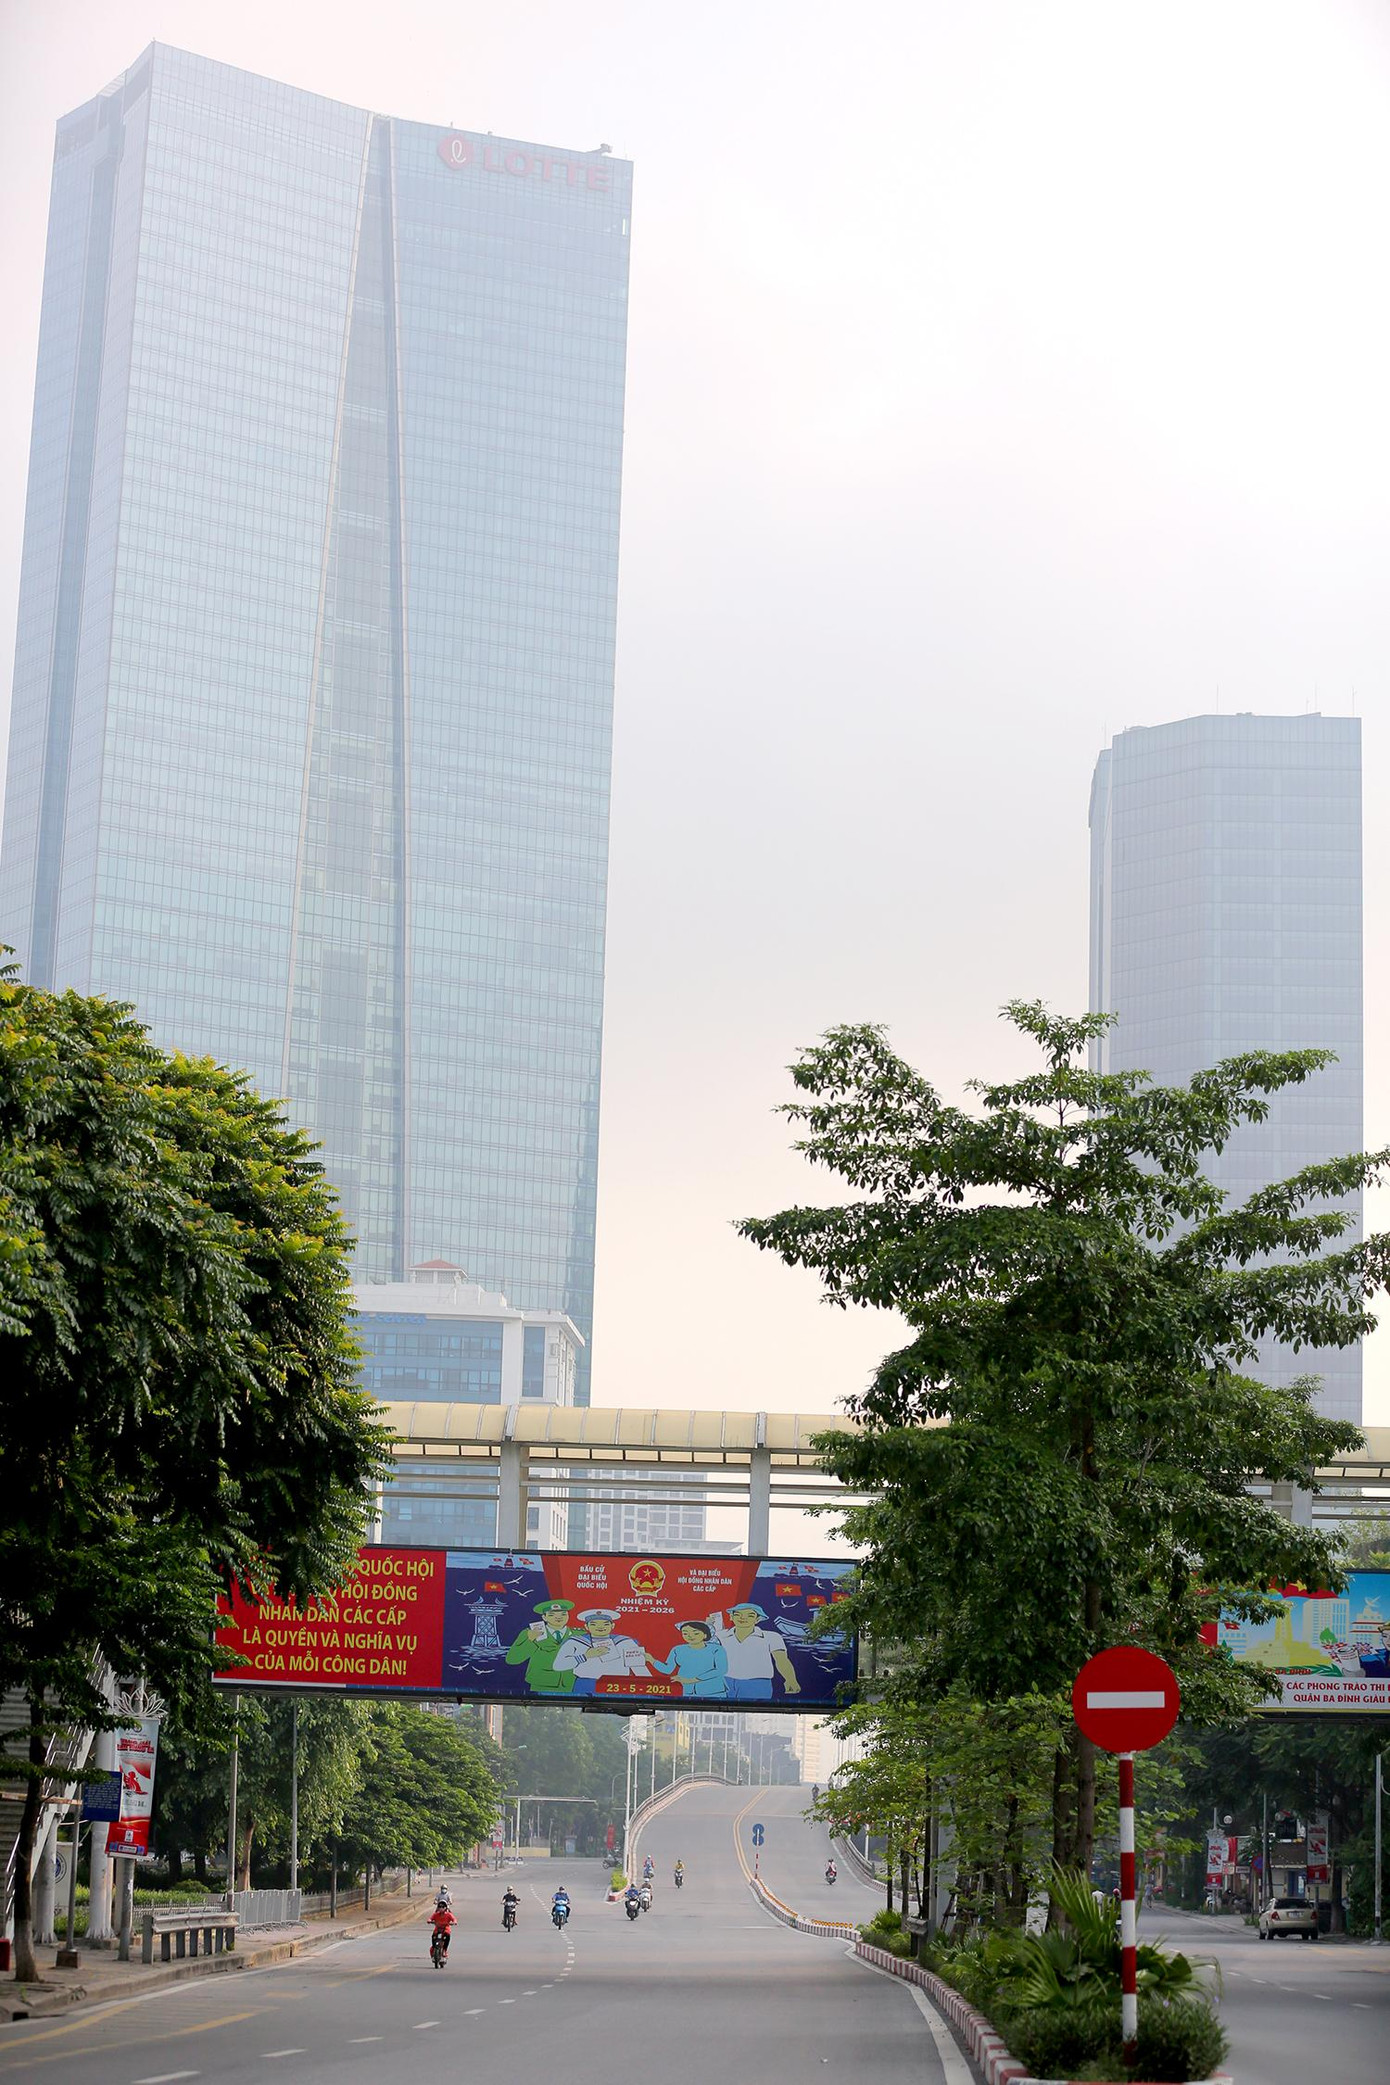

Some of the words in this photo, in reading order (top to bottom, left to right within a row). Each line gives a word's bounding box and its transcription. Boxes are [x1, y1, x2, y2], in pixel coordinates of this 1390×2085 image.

[483, 146, 609, 193] LOTTE
[359, 1555, 403, 1577] QUỐC
[406, 1558, 434, 1581] HỘI
[341, 1580, 369, 1603] HỘI
[371, 1580, 417, 1601] ĐỒNG
[620, 1597, 652, 1605] NHIỆM
[343, 1605, 373, 1624] CÁC
[376, 1605, 407, 1625] CẤP
[615, 1605, 640, 1613] 2021
[650, 1606, 675, 1614] 2026
[243, 1626, 262, 1645] LÀ
[265, 1625, 317, 1648] QUYỀN
[320, 1628, 341, 1648] VÀ
[344, 1630, 392, 1650] NGHĨA
[397, 1635, 418, 1655] VỤ
[254, 1650, 286, 1671] CỦA
[289, 1650, 319, 1672] MỖI
[322, 1654, 366, 1674] CÔNG
[369, 1656, 407, 1676] DÂN!
[606, 1683, 621, 1693] 23
[629, 1684, 636, 1693] 5
[646, 1684, 672, 1694] 2021
[1307, 1682, 1340, 1691] PHONG
[1370, 1683, 1385, 1691] THI
[1293, 1693, 1321, 1703] QUẬN
[1323, 1694, 1335, 1702] BA
